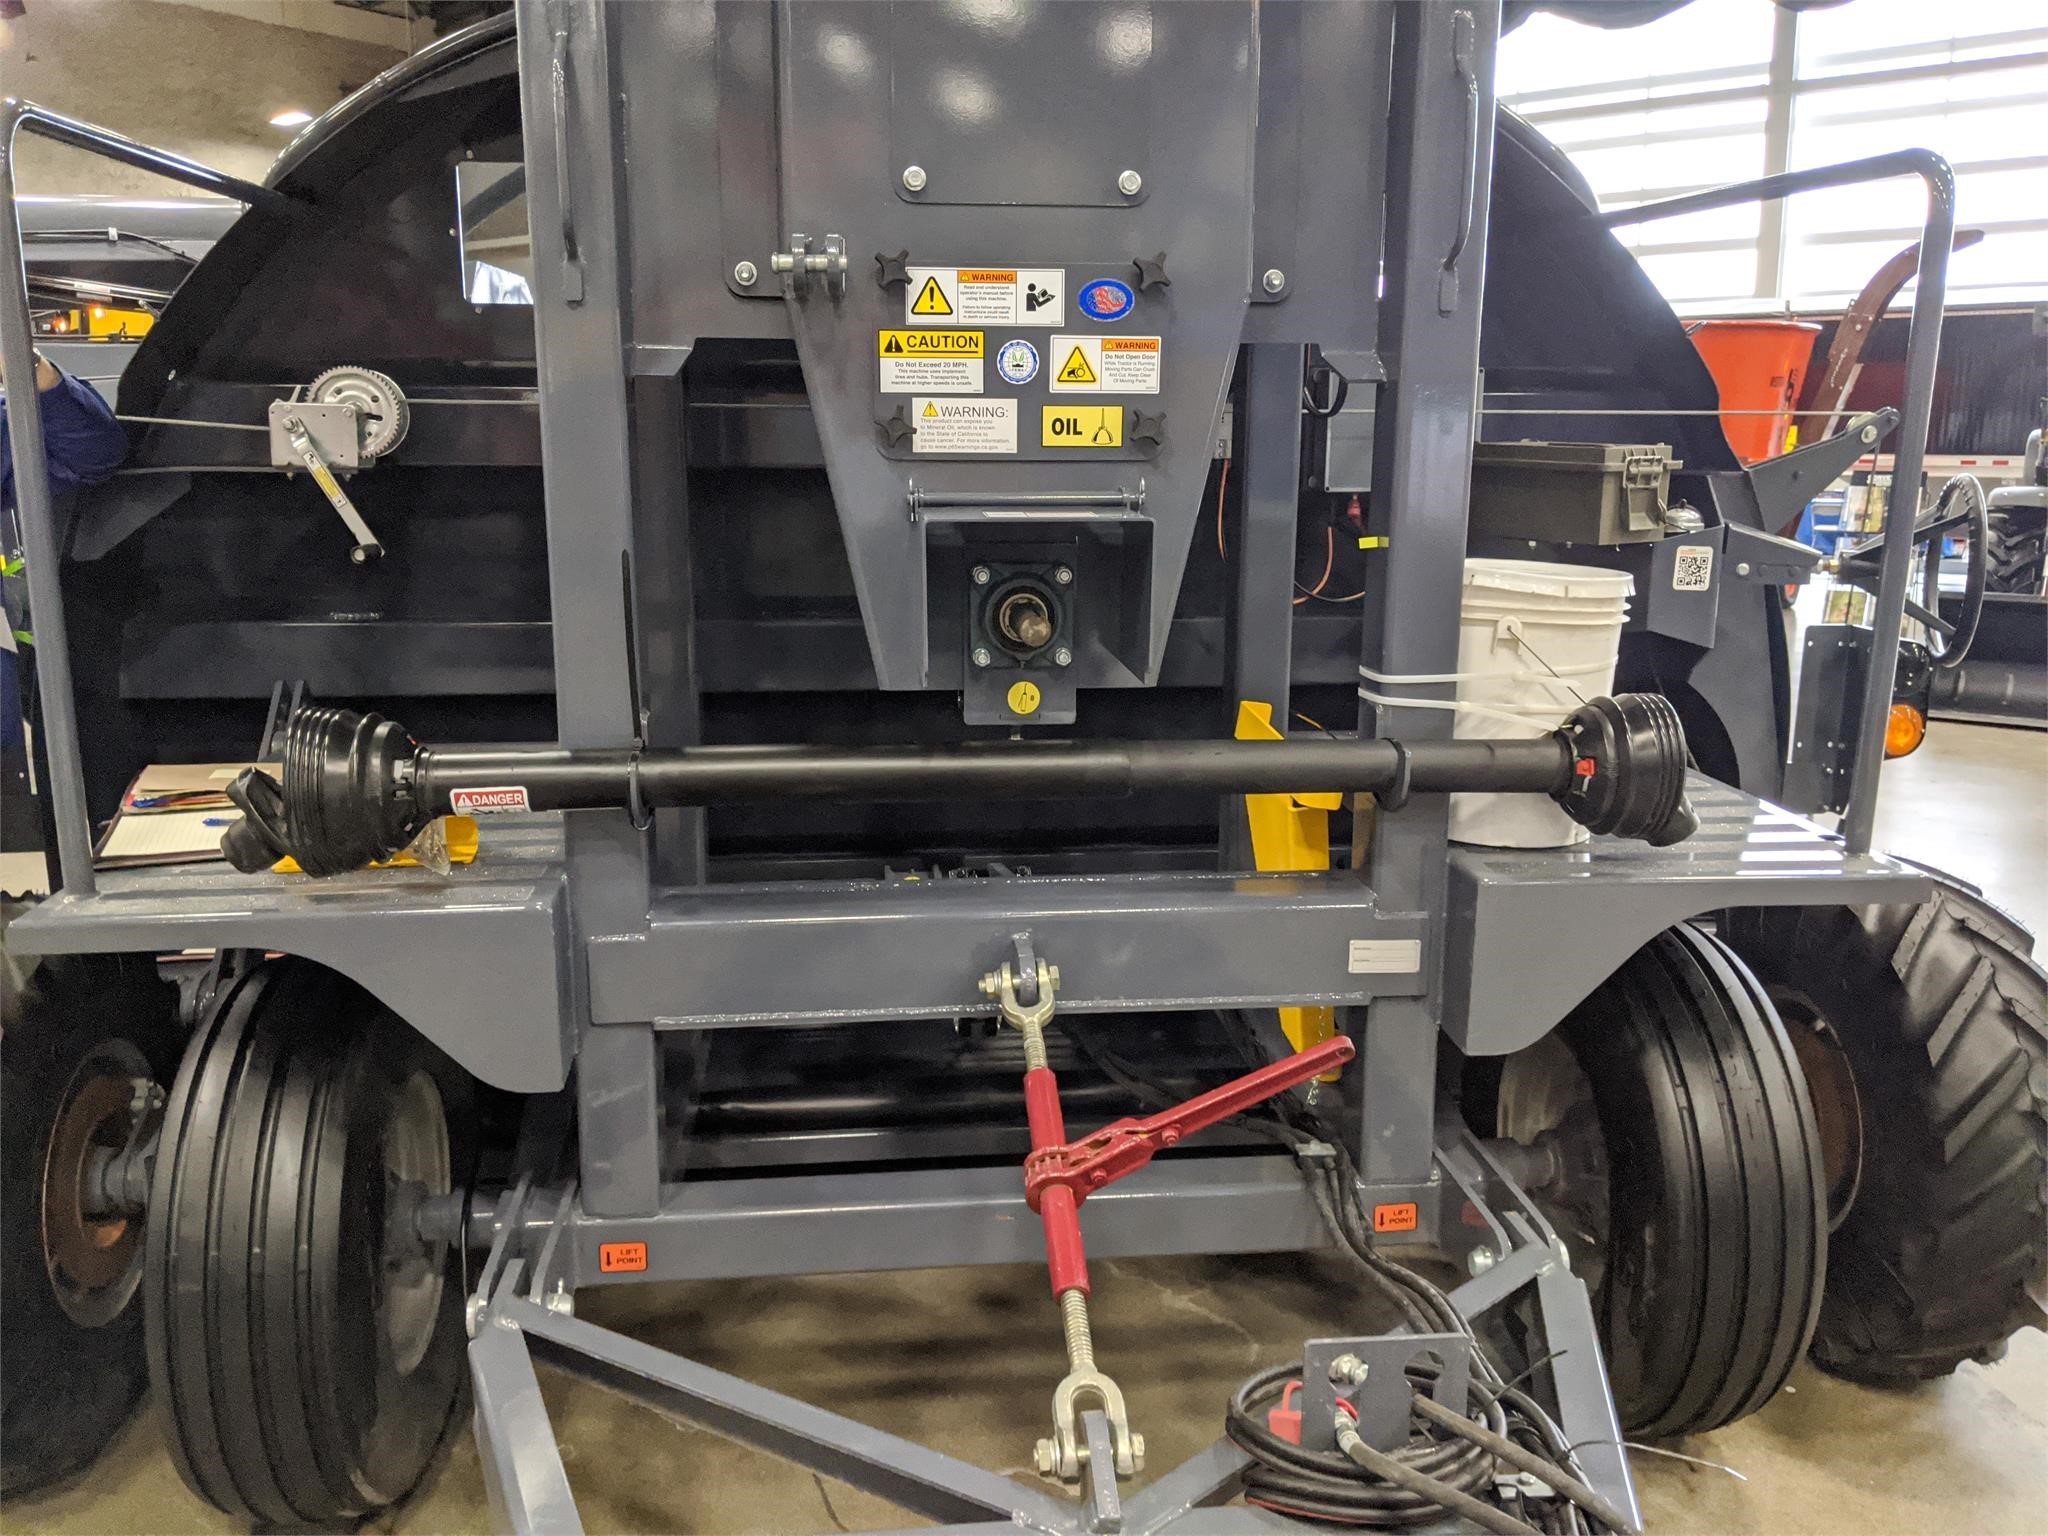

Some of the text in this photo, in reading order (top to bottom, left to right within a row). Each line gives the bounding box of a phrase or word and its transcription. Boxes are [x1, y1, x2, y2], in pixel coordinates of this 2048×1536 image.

[972, 273, 1014, 281] WARNING
[906, 335, 979, 348] CAUTION
[1115, 342, 1156, 350] WARNING
[940, 406, 1009, 418] WARNING:
[1051, 417, 1083, 436] OIL
[472, 793, 523, 805] DANGER
